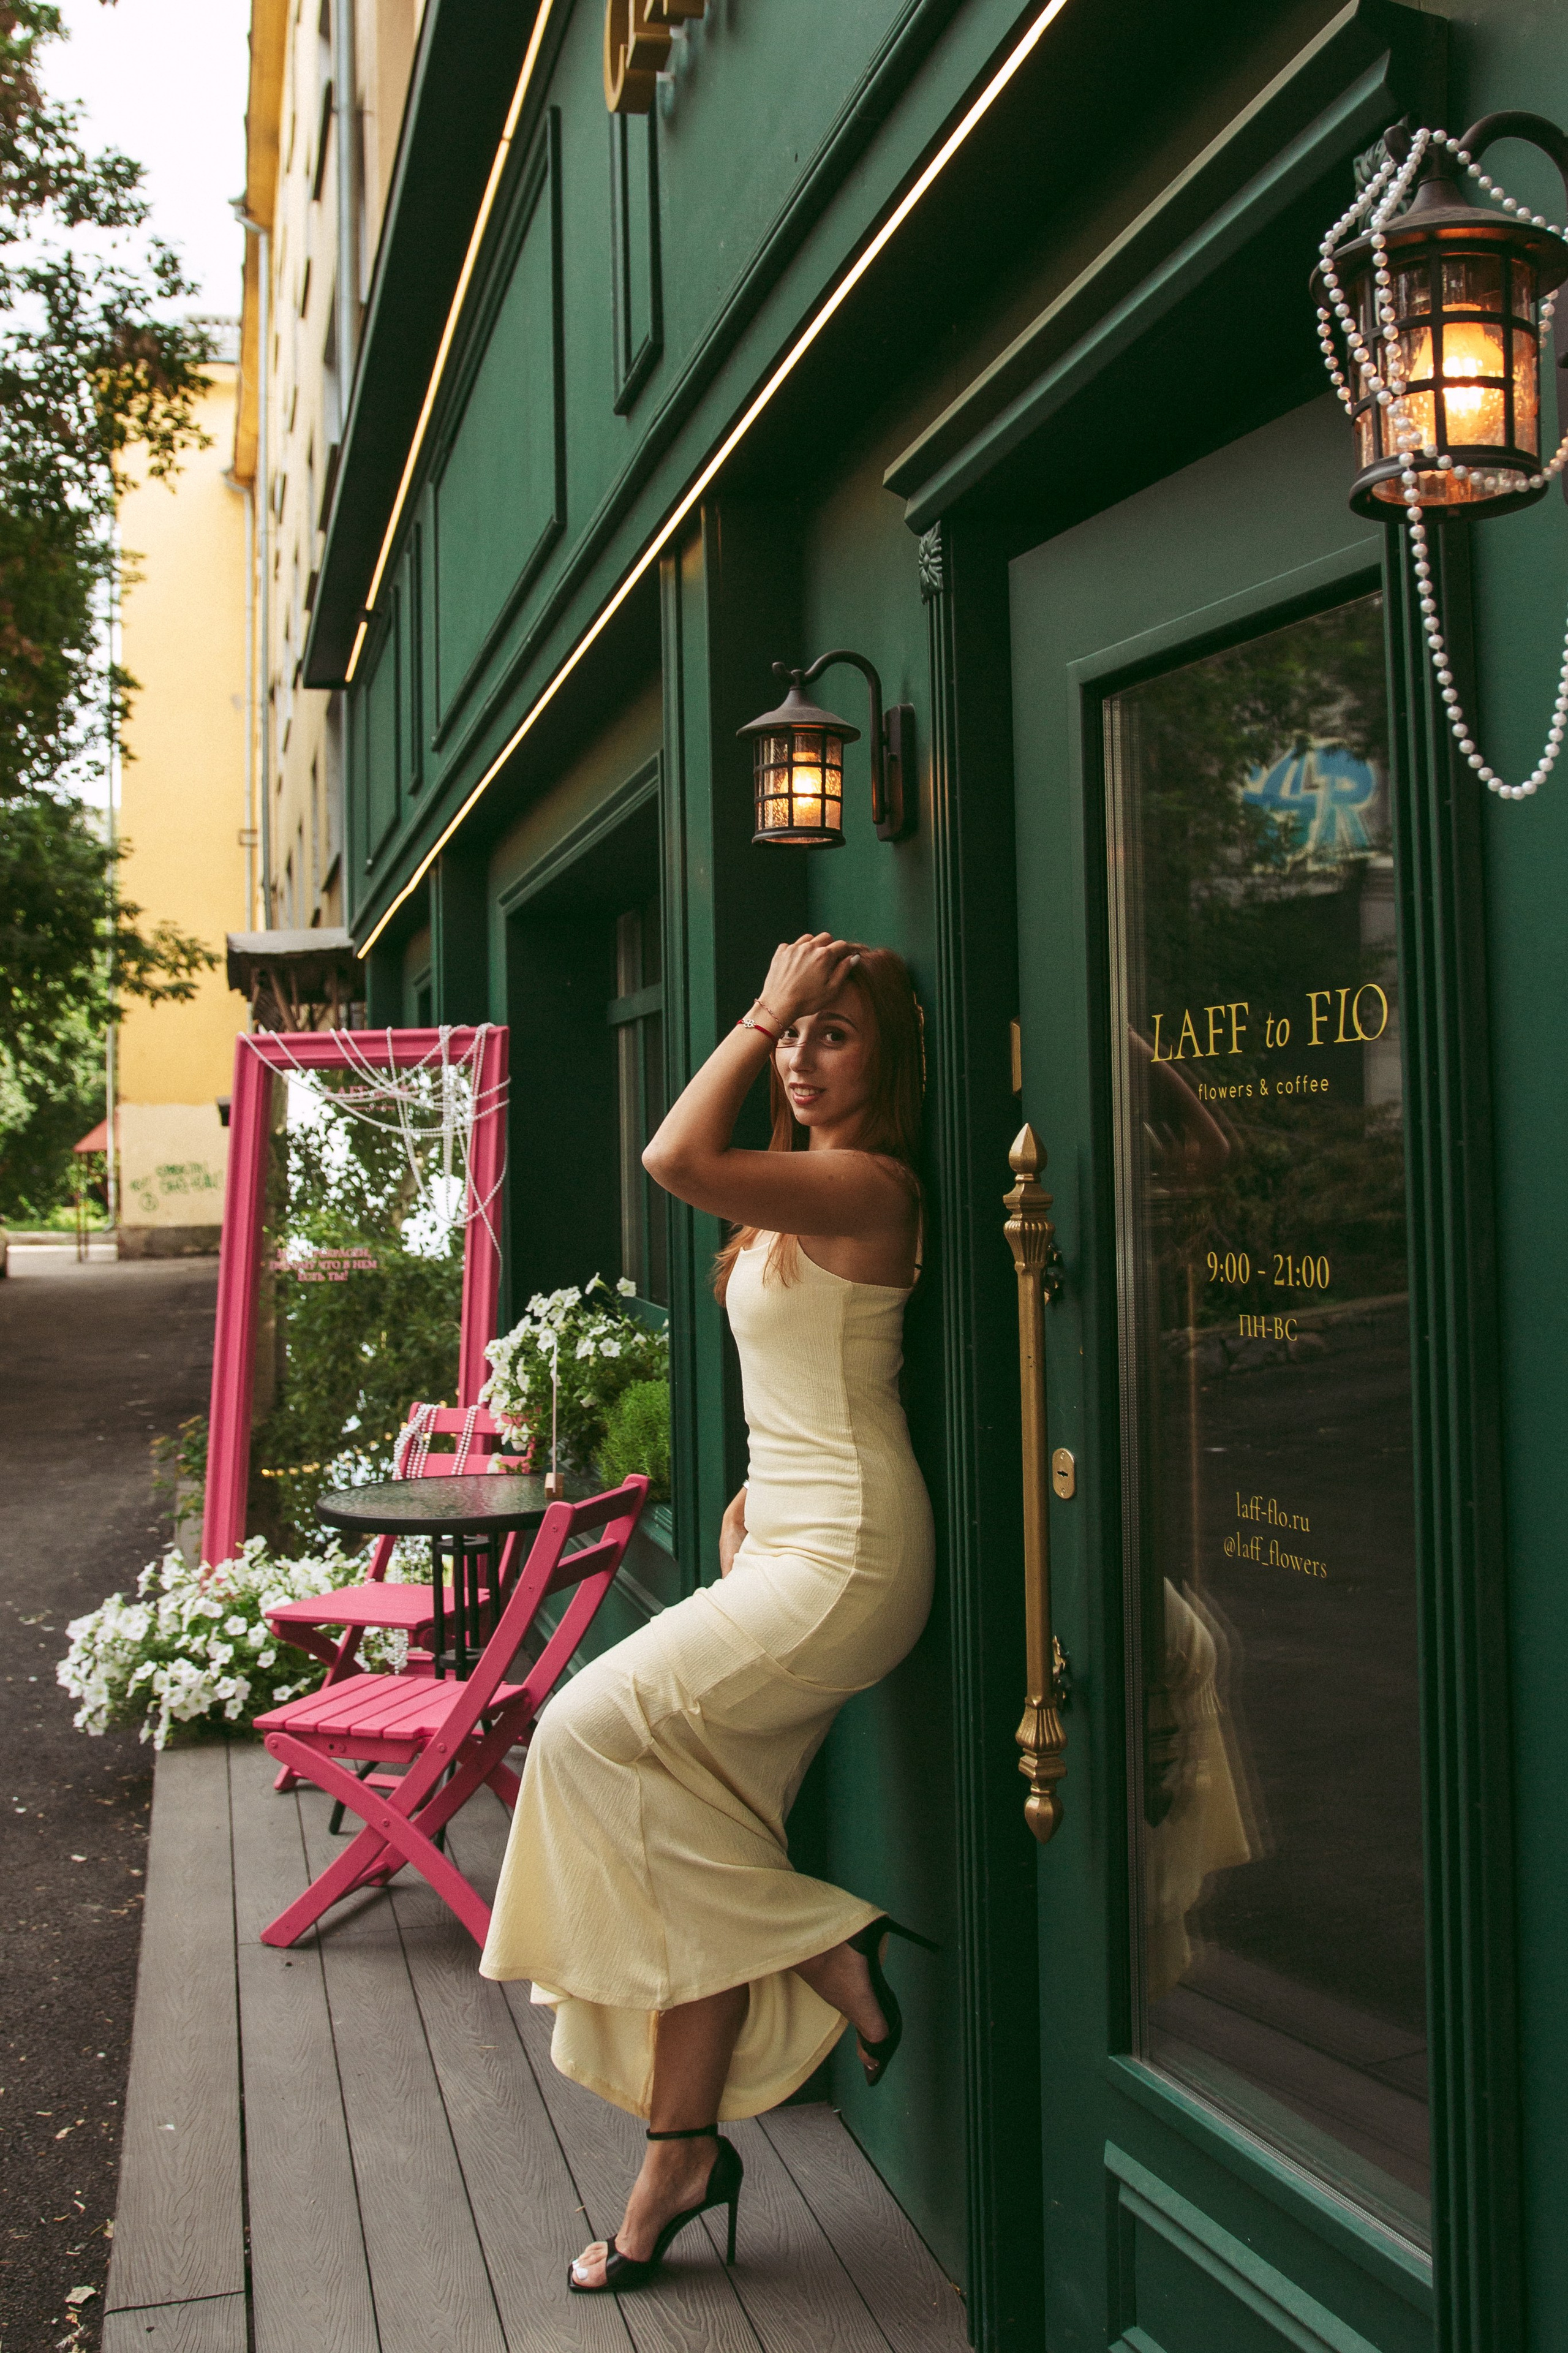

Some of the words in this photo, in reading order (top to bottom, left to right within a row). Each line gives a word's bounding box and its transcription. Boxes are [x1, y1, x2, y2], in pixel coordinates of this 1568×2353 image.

[1150, 1002, 1249, 1063] LAFF
[1265, 1011, 1290, 1048] to
[1306, 983, 1388, 1046] FLO
[1199, 1082, 1253, 1100] flowers
[1259, 1078, 1268, 1096] &
[1276, 1075, 1329, 1095] coffee
[306, 1247, 371, 1260] РЕКРАСЕН,
[1207, 1251, 1250, 1284] 9:00
[1273, 1254, 1330, 1289] 21:00
[1238, 1314, 1297, 1342] ПН-ВС
[1236, 1491, 1310, 1532] laff-flo.ru
[1224, 1532, 1327, 1579] @laff_flowers
